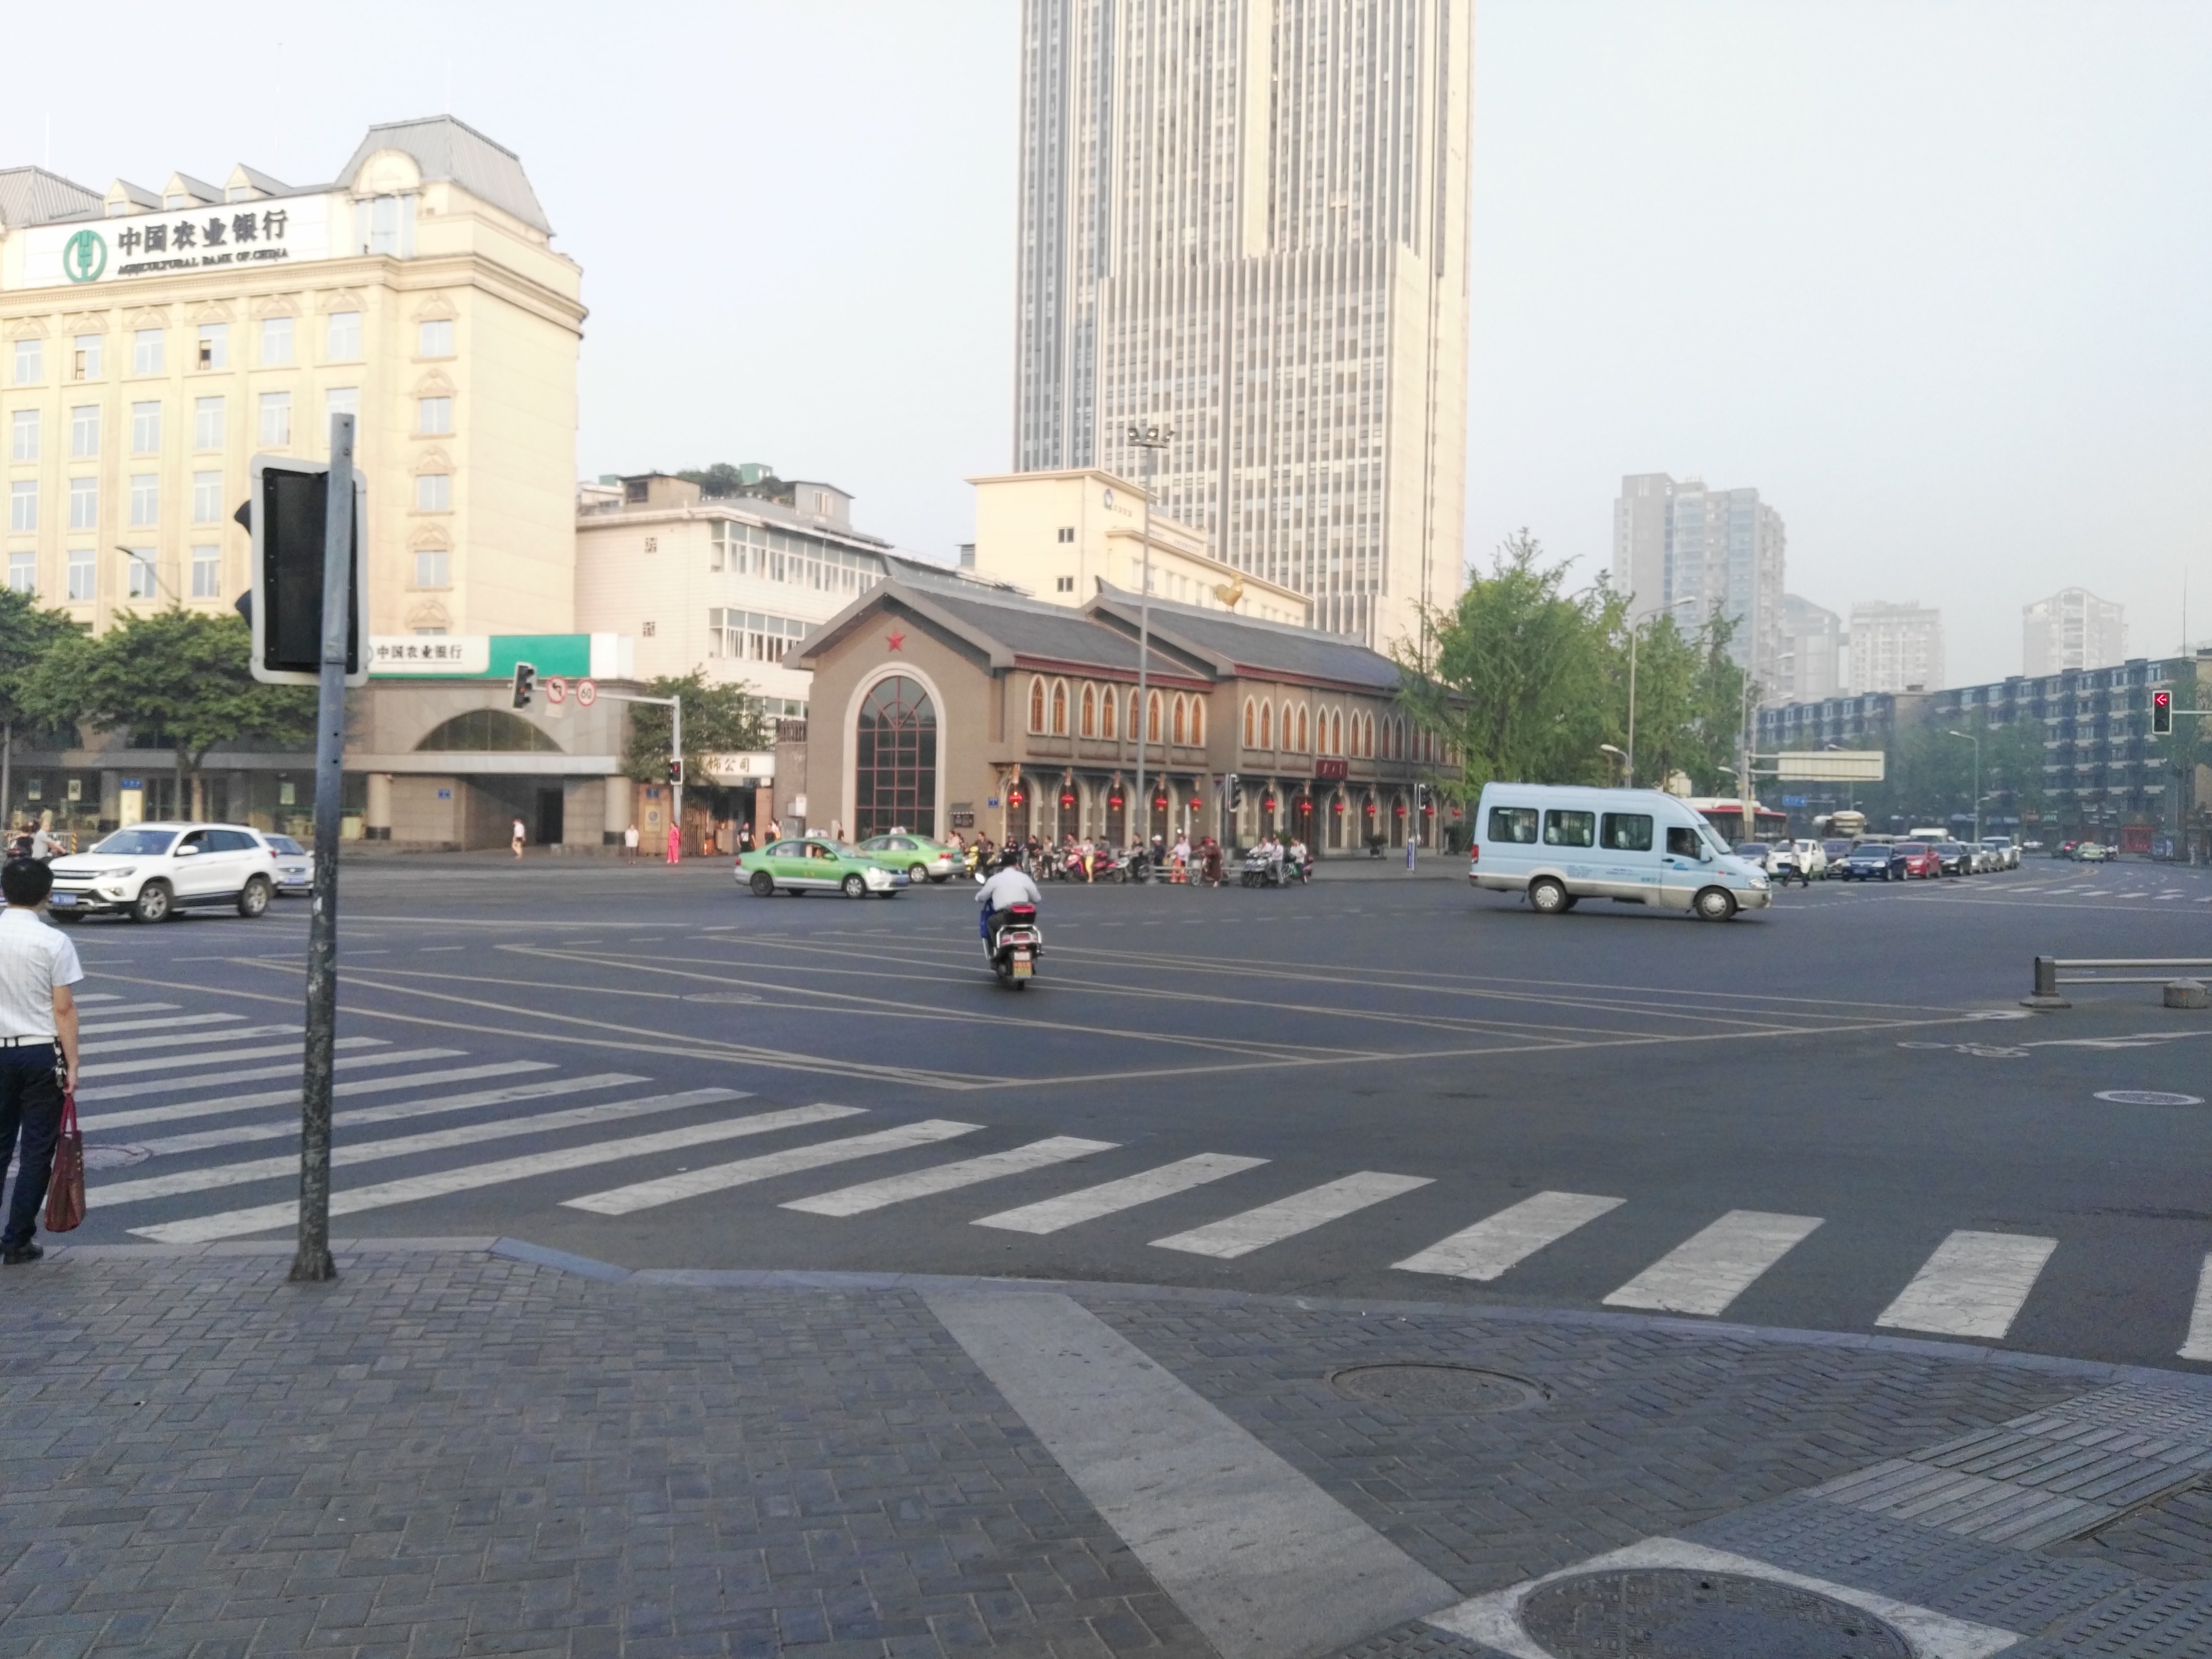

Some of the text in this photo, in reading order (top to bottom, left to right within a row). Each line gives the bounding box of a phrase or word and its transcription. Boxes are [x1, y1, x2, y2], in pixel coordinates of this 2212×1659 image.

[118, 209, 289, 257] 中国农业银行
[202, 252, 233, 266] BANK
[236, 250, 250, 262] OF
[253, 247, 288, 262] CHINA
[377, 644, 462, 660] 中国农业银行
[581, 688, 592, 699] 60
[696, 756, 750, 773] 饰公司
